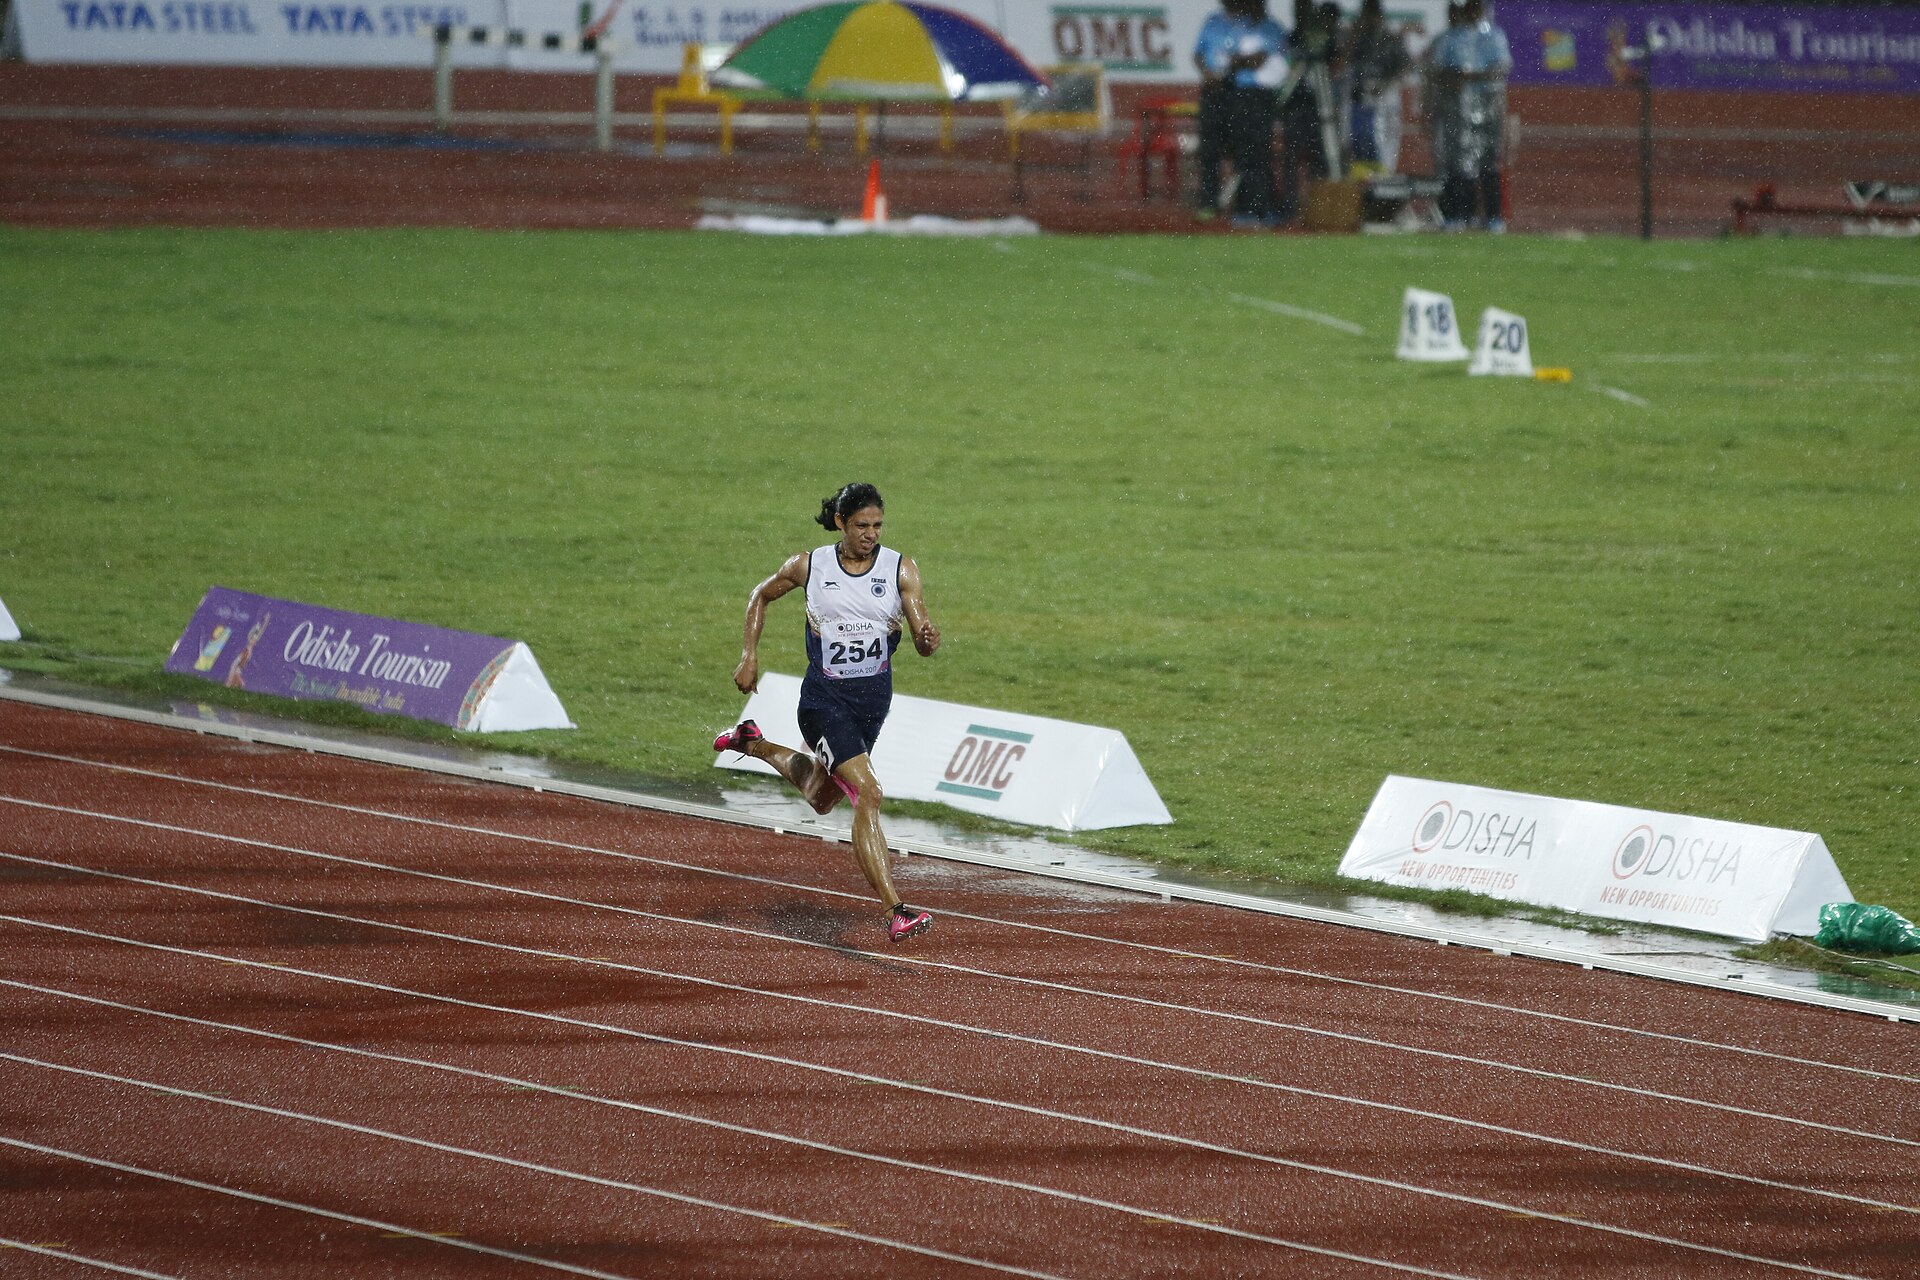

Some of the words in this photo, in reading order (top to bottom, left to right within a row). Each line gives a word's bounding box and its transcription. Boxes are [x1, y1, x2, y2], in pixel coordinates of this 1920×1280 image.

[61, 3, 155, 30] TATA
[162, 4, 257, 34] STEEL
[281, 5, 375, 35] TATA
[1053, 16, 1172, 58] OMC
[1491, 320, 1525, 354] 20
[836, 622, 874, 633] ODISHA
[284, 620, 360, 673] Odisha
[358, 633, 451, 689] Tourism
[829, 637, 883, 665] 254
[944, 736, 1027, 790] OMC
[1412, 800, 1538, 860] ODISHA
[1613, 824, 1743, 886] ODISHA
[1399, 859, 1427, 878] NEW
[1427, 863, 1519, 890] OPPORTUNITIES
[1599, 885, 1629, 905] NEW
[1628, 889, 1722, 916] OPPORTUNITIES
